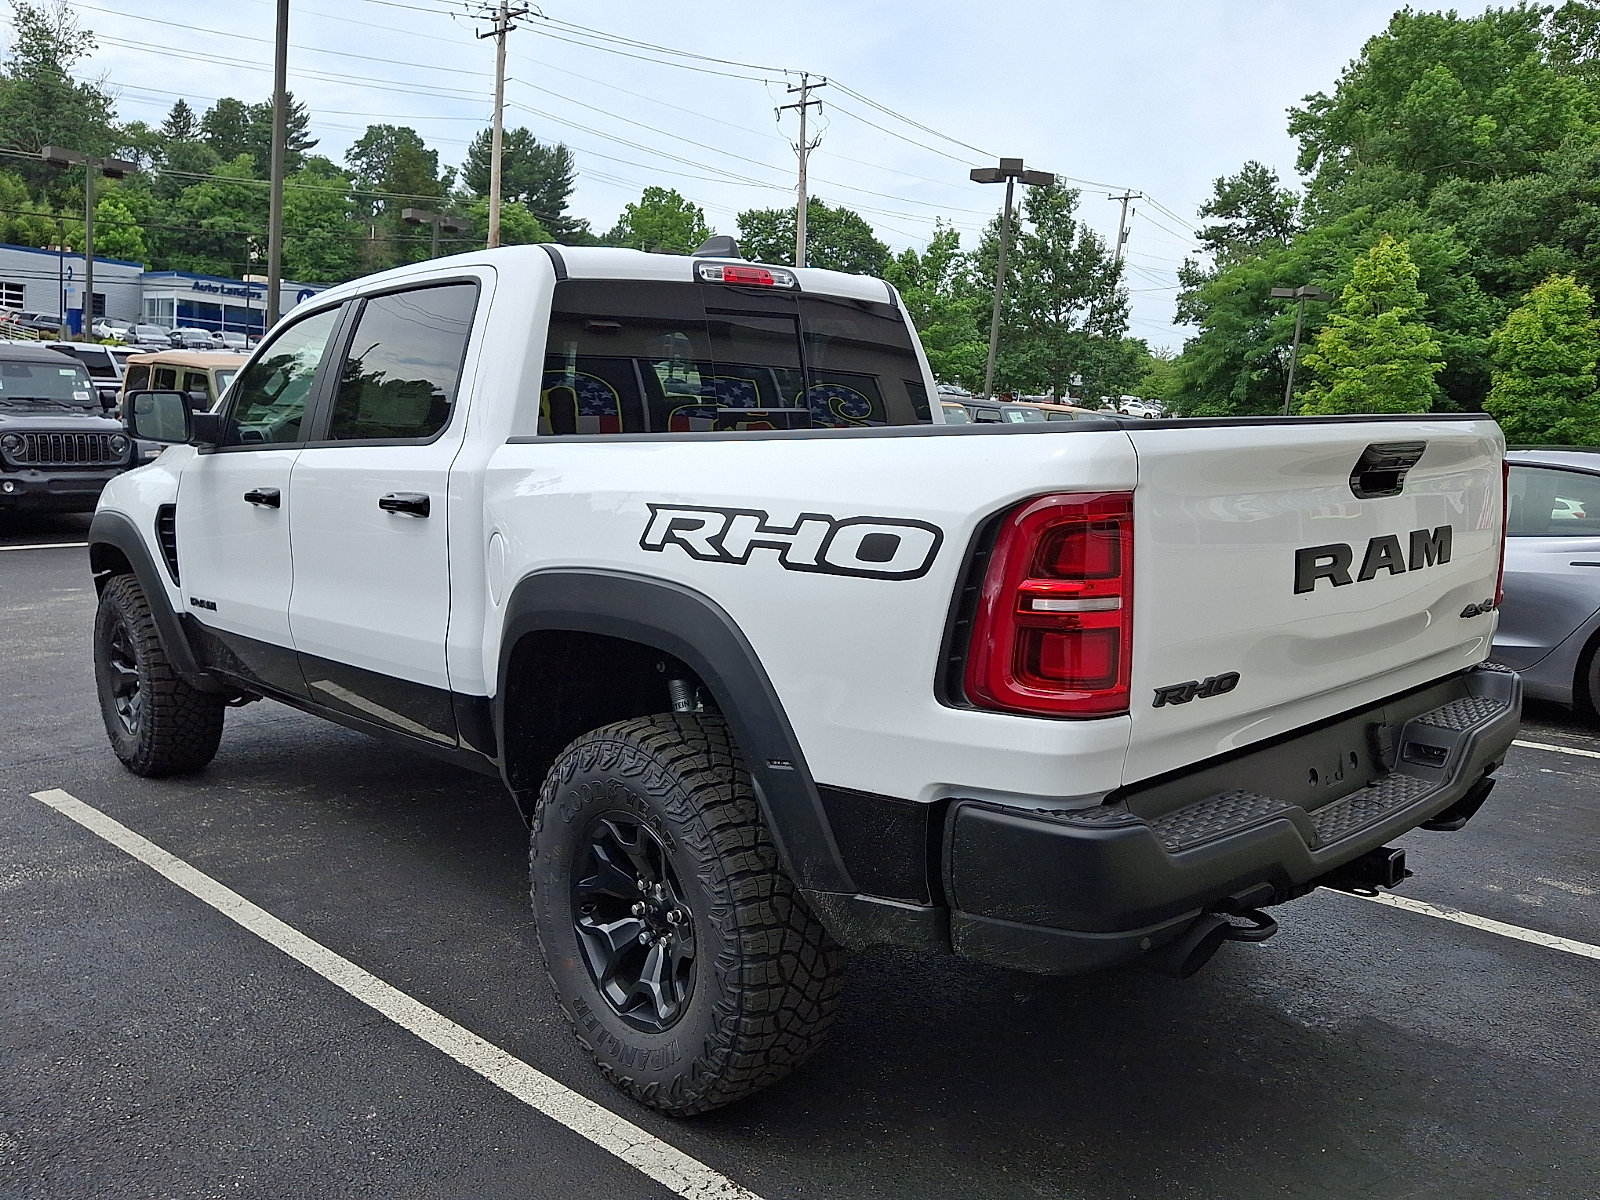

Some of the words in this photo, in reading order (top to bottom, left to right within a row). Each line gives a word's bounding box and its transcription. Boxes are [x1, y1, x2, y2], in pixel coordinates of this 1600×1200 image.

[192, 281, 219, 294] Auto
[639, 503, 945, 581] RHO
[1294, 525, 1452, 595] RAM
[1152, 671, 1240, 708] RHO
